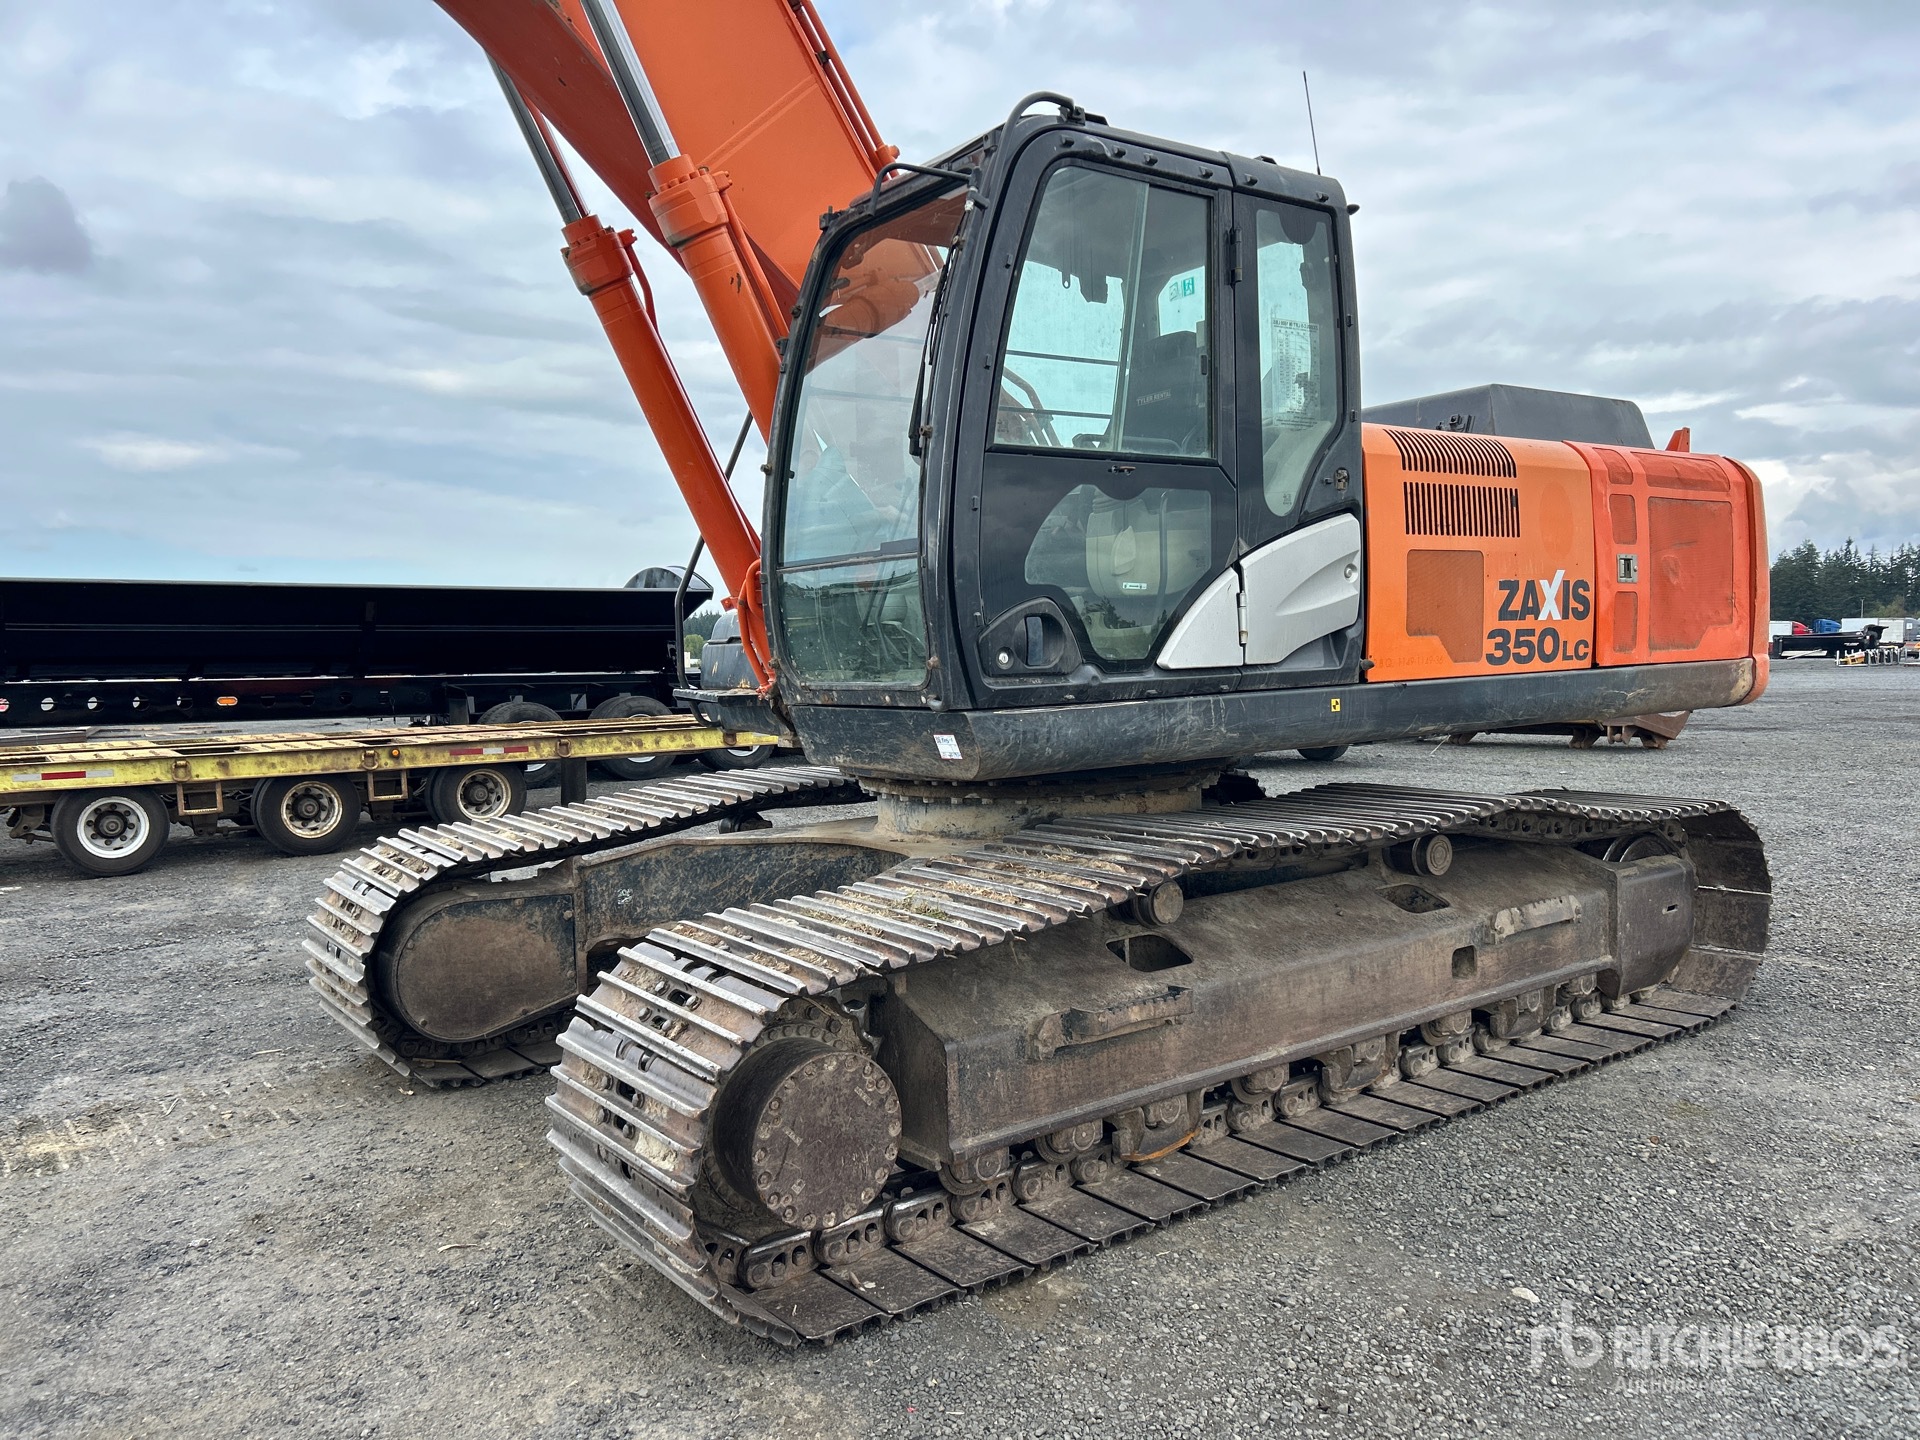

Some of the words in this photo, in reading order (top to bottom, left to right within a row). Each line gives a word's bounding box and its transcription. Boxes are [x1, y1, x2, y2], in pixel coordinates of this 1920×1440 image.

[1136, 395, 1153, 406] TYLER
[1153, 389, 1171, 400] RENTAL
[1498, 570, 1590, 621] ZAXIS
